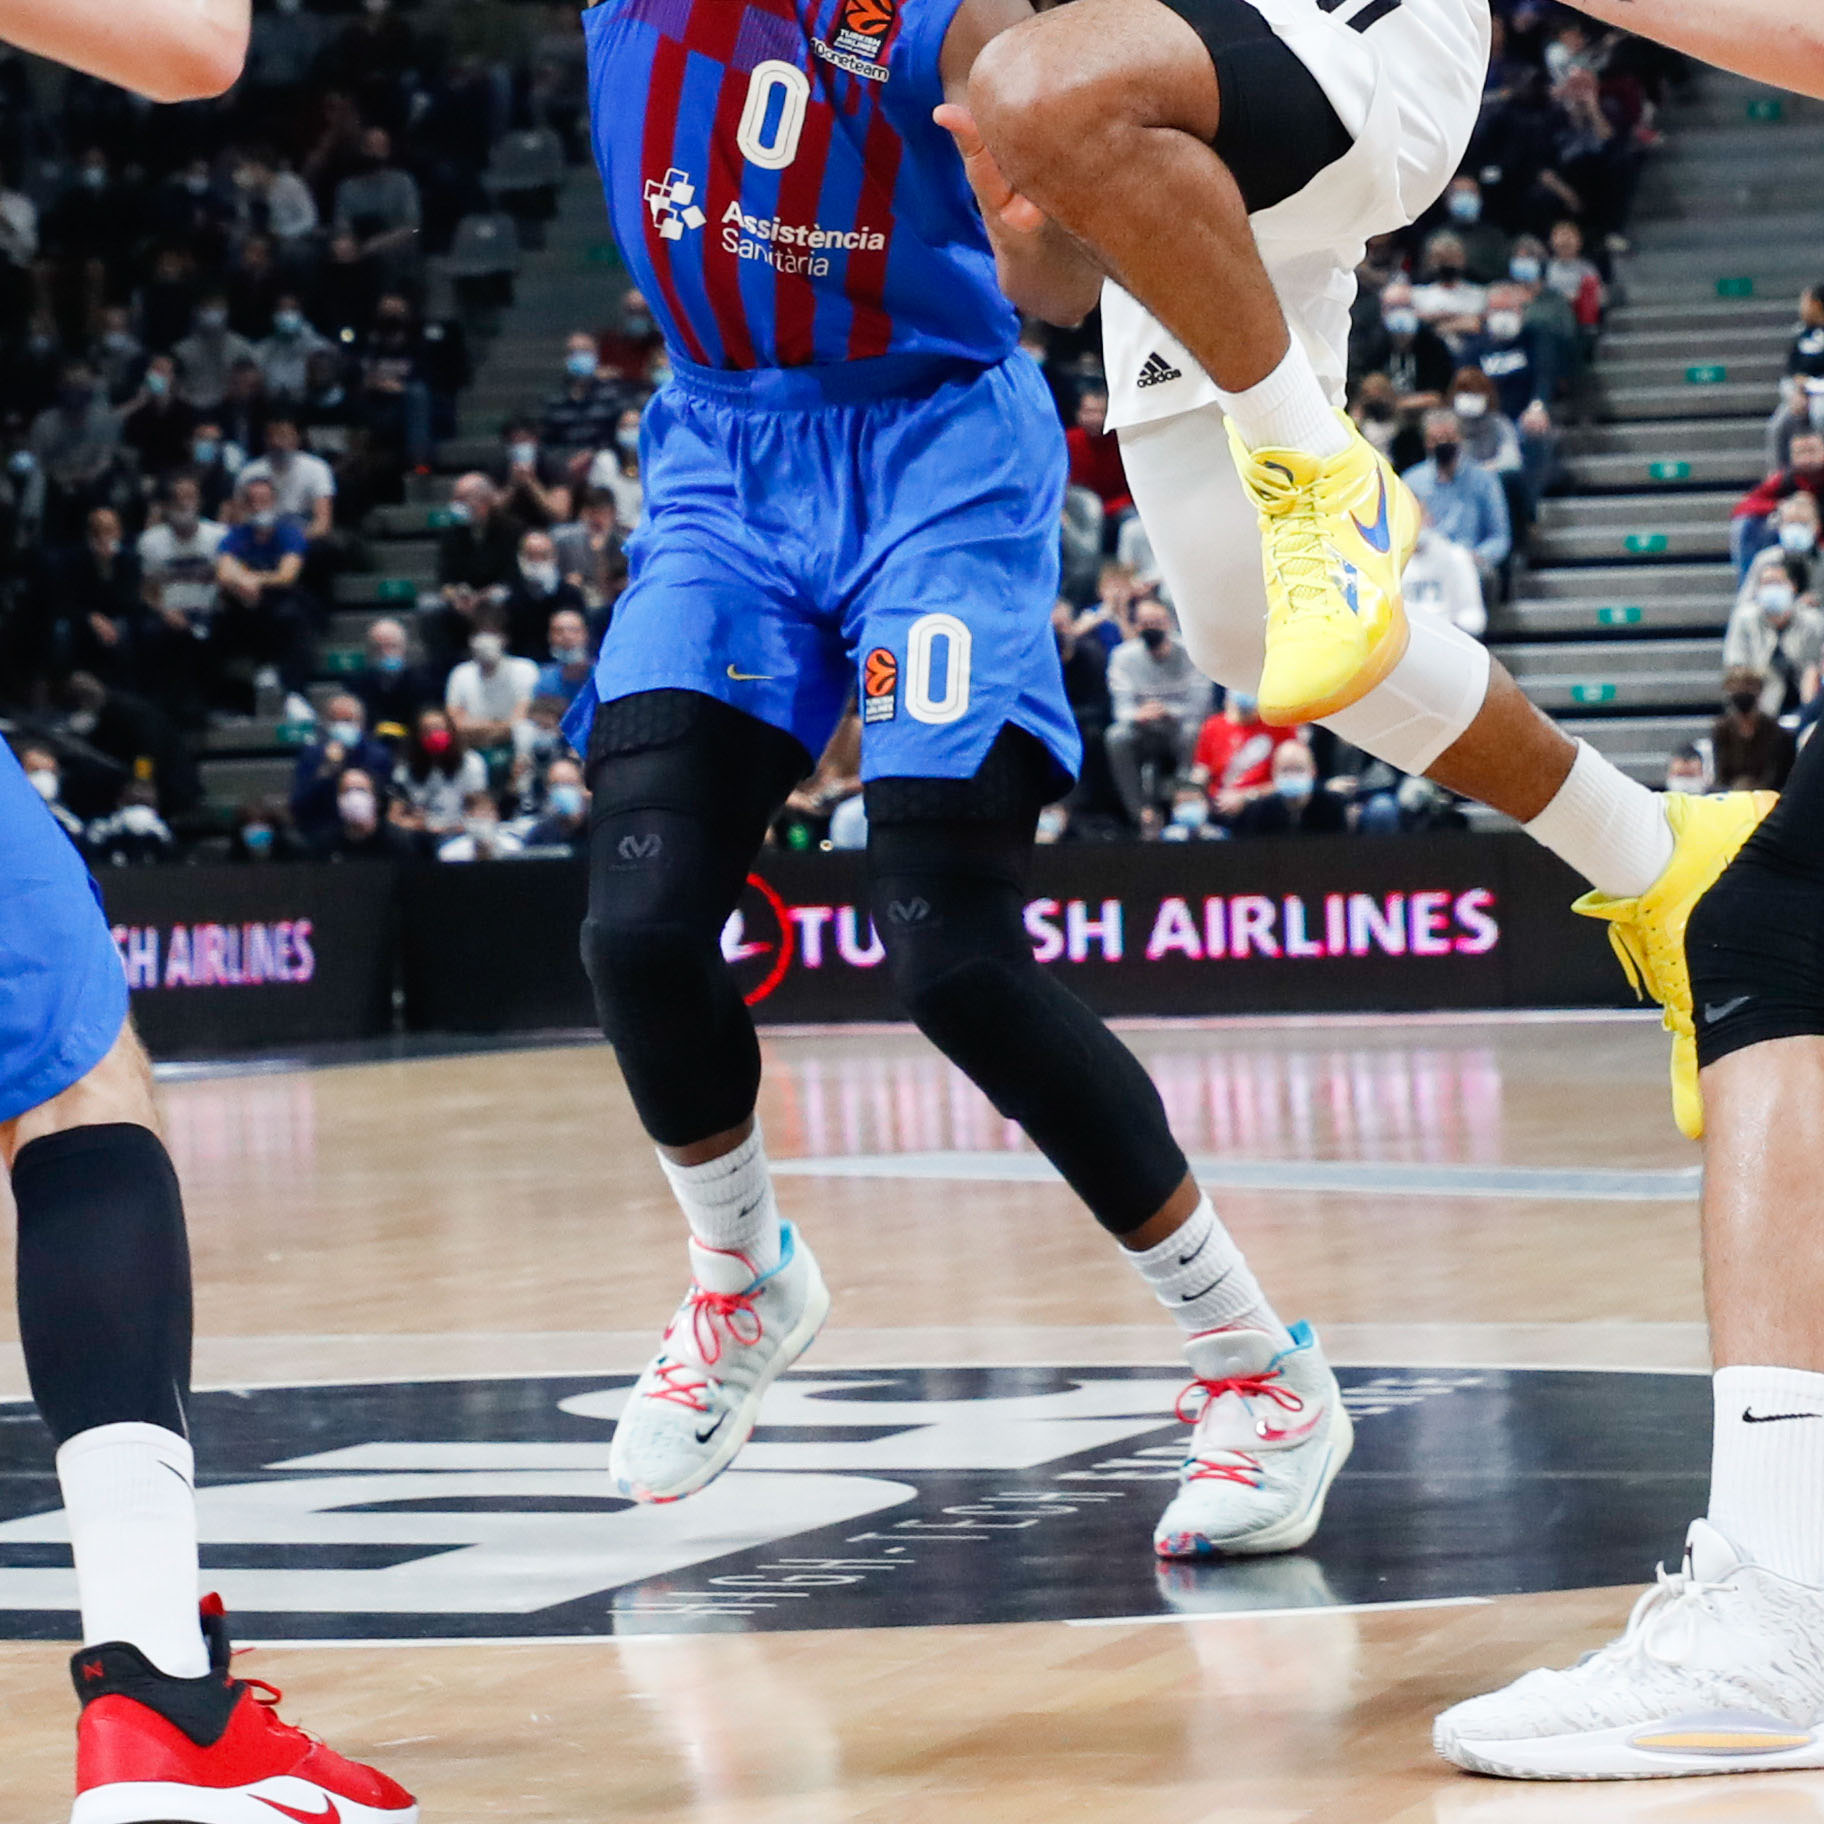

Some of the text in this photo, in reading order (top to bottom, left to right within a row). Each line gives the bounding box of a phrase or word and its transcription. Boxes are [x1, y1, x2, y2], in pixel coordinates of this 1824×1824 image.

[736, 59, 811, 170] 0
[721, 200, 885, 250] Assistència
[721, 227, 830, 276] Sanitària
[1137, 368, 1183, 389] adidas
[904, 613, 973, 724] 0
[164, 917, 316, 989] AIRLINES
[1146, 888, 1500, 962] AIRLINES
[606, 1490, 1125, 1615] HIGH-TECH
